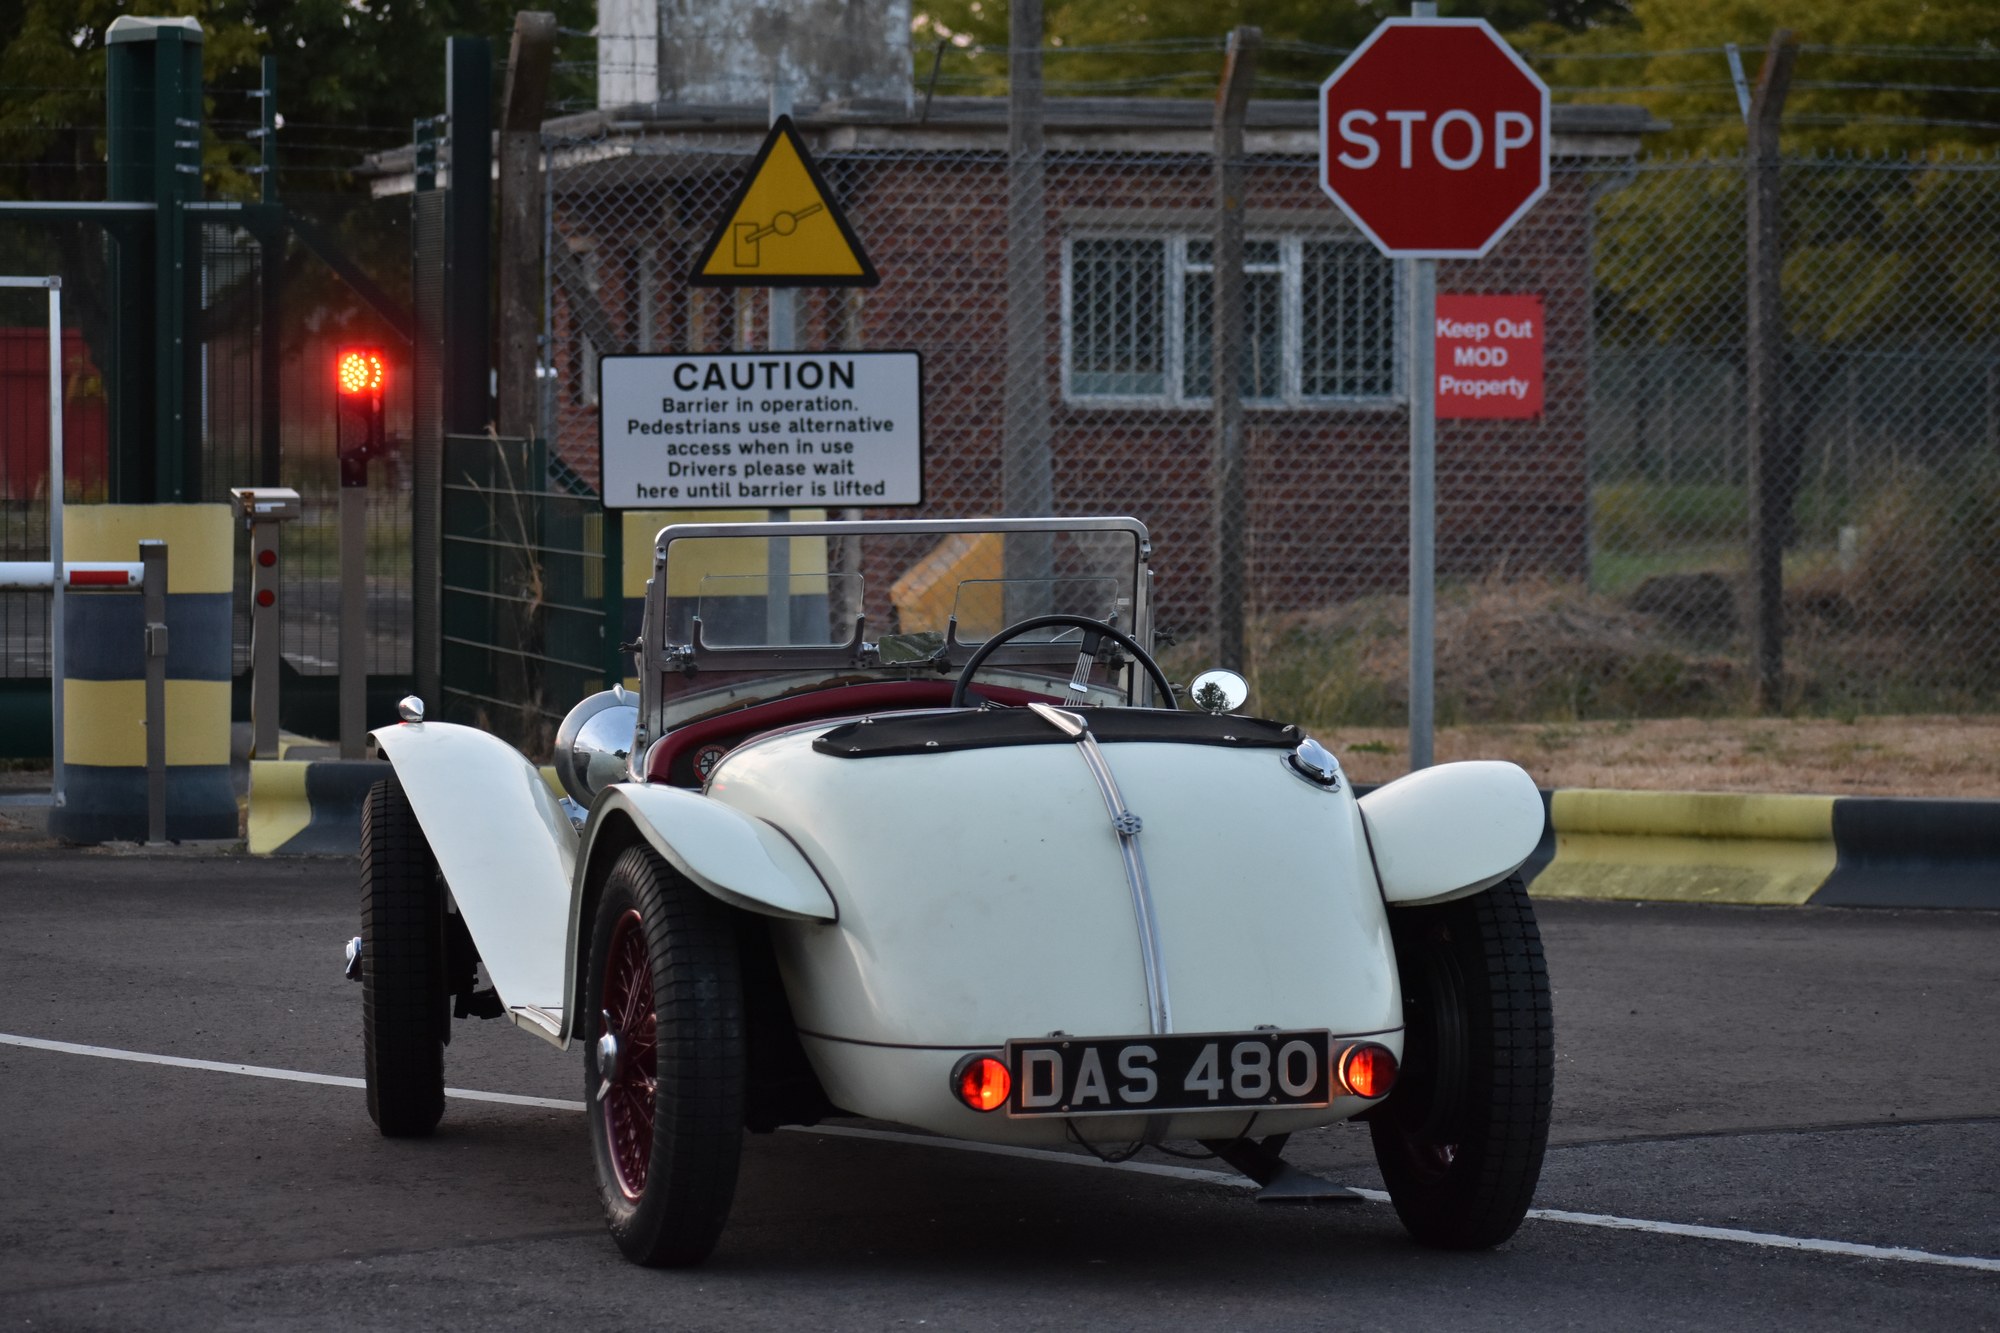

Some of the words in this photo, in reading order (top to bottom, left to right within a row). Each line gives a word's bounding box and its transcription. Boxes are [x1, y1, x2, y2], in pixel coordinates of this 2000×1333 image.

[1338, 110, 1533, 170] STOP
[1436, 318, 1490, 342] Keep
[1494, 318, 1533, 338] Out
[1454, 346, 1508, 367] MOD
[674, 361, 854, 391] CAUTION
[1439, 374, 1529, 400] Property
[662, 397, 729, 413] Barrier
[736, 396, 754, 412] in
[760, 395, 858, 414] operation.
[627, 418, 741, 435] Pedestrians
[748, 421, 782, 433] use
[788, 416, 894, 433] alternative
[666, 443, 732, 455] access
[738, 439, 790, 454] when
[796, 438, 814, 454] in
[820, 441, 854, 454] use
[668, 460, 738, 477] Drivers
[744, 460, 807, 478] please
[812, 459, 854, 475] wait
[636, 483, 679, 498] here
[686, 481, 732, 498] until
[738, 481, 804, 497] barrier
[811, 480, 827, 496] is
[833, 480, 885, 496] lifted
[1022, 1045, 1158, 1108] DAS
[1184, 1040, 1317, 1100] 480
